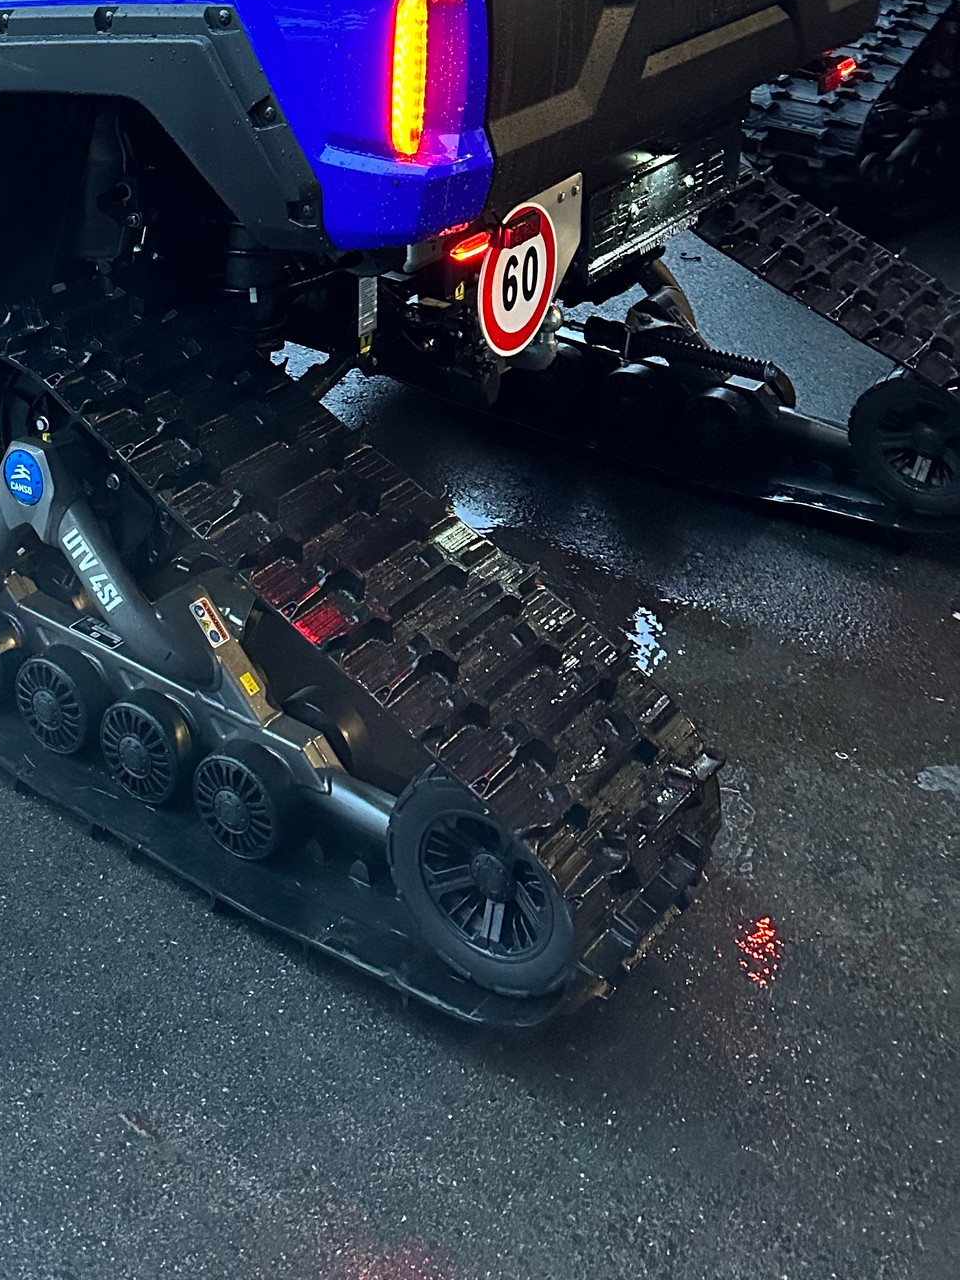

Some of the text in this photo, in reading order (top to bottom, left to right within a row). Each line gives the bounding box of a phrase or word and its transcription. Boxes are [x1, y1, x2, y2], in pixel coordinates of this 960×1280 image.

[502, 246, 538, 311] 60
[10, 481, 33, 495] CAMSO
[62, 528, 99, 572] UTV
[89, 573, 124, 612] 4S1
